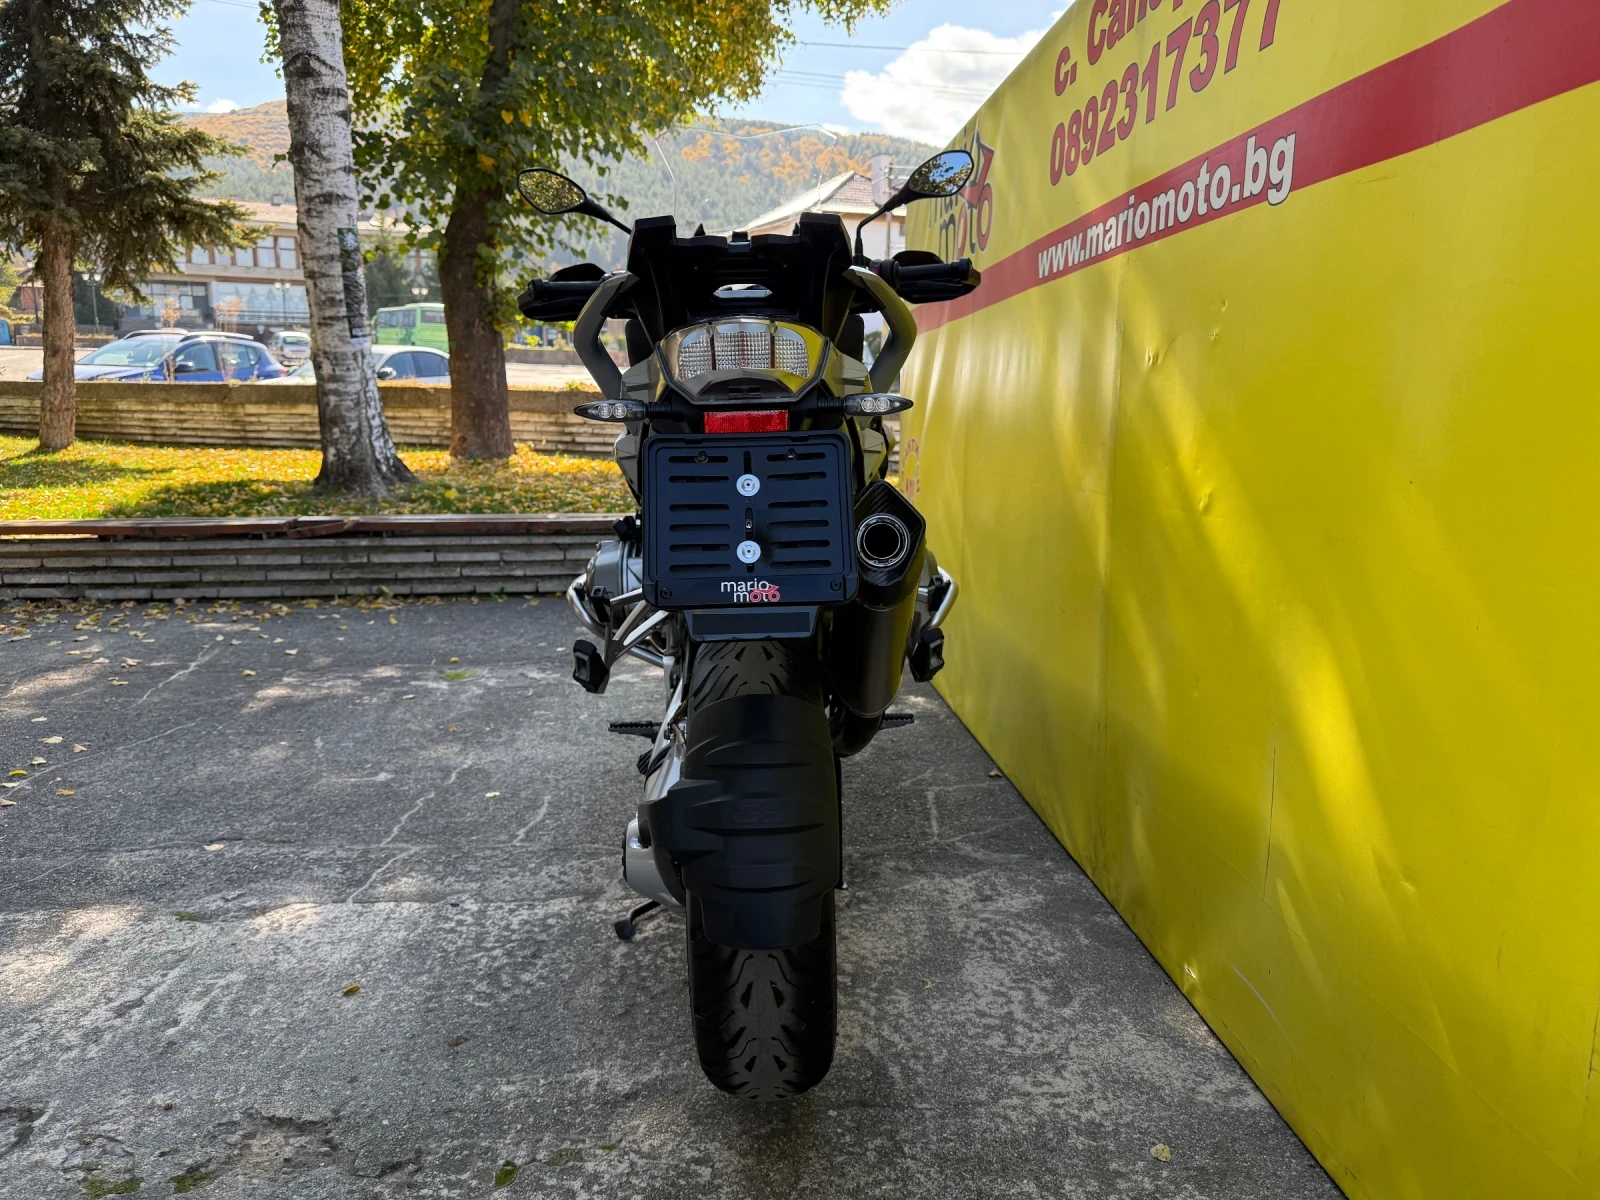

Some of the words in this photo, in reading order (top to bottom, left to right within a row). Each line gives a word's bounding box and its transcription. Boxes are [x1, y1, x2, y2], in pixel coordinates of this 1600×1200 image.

[1038, 132, 1297, 279] www.mariomoto.bg
[720, 578, 769, 592] mario
[733, 591, 780, 602] moto
